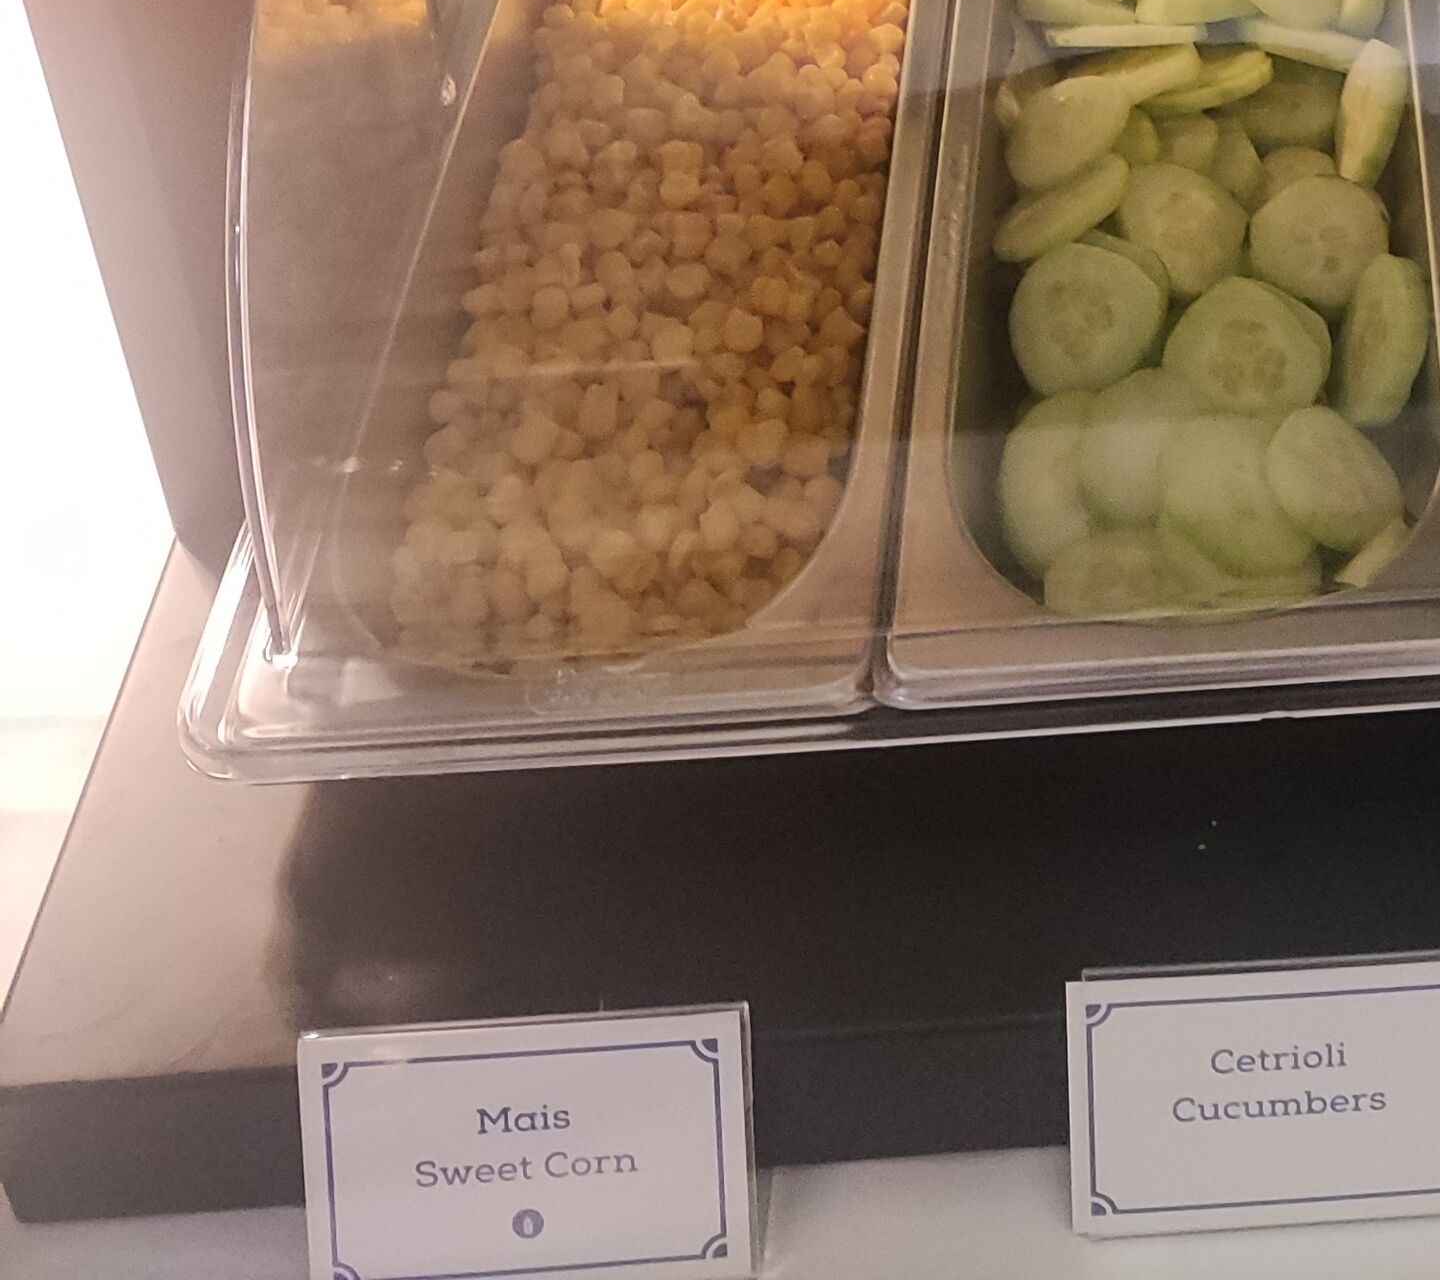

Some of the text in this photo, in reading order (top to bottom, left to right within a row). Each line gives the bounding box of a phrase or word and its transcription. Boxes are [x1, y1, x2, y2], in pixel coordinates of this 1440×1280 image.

[1210, 1042, 1347, 1075] Cetrioli
[476, 1104, 572, 1135] Mais
[1172, 1089, 1387, 1123] Cucumbers
[414, 1151, 639, 1188] Sweet Corn
